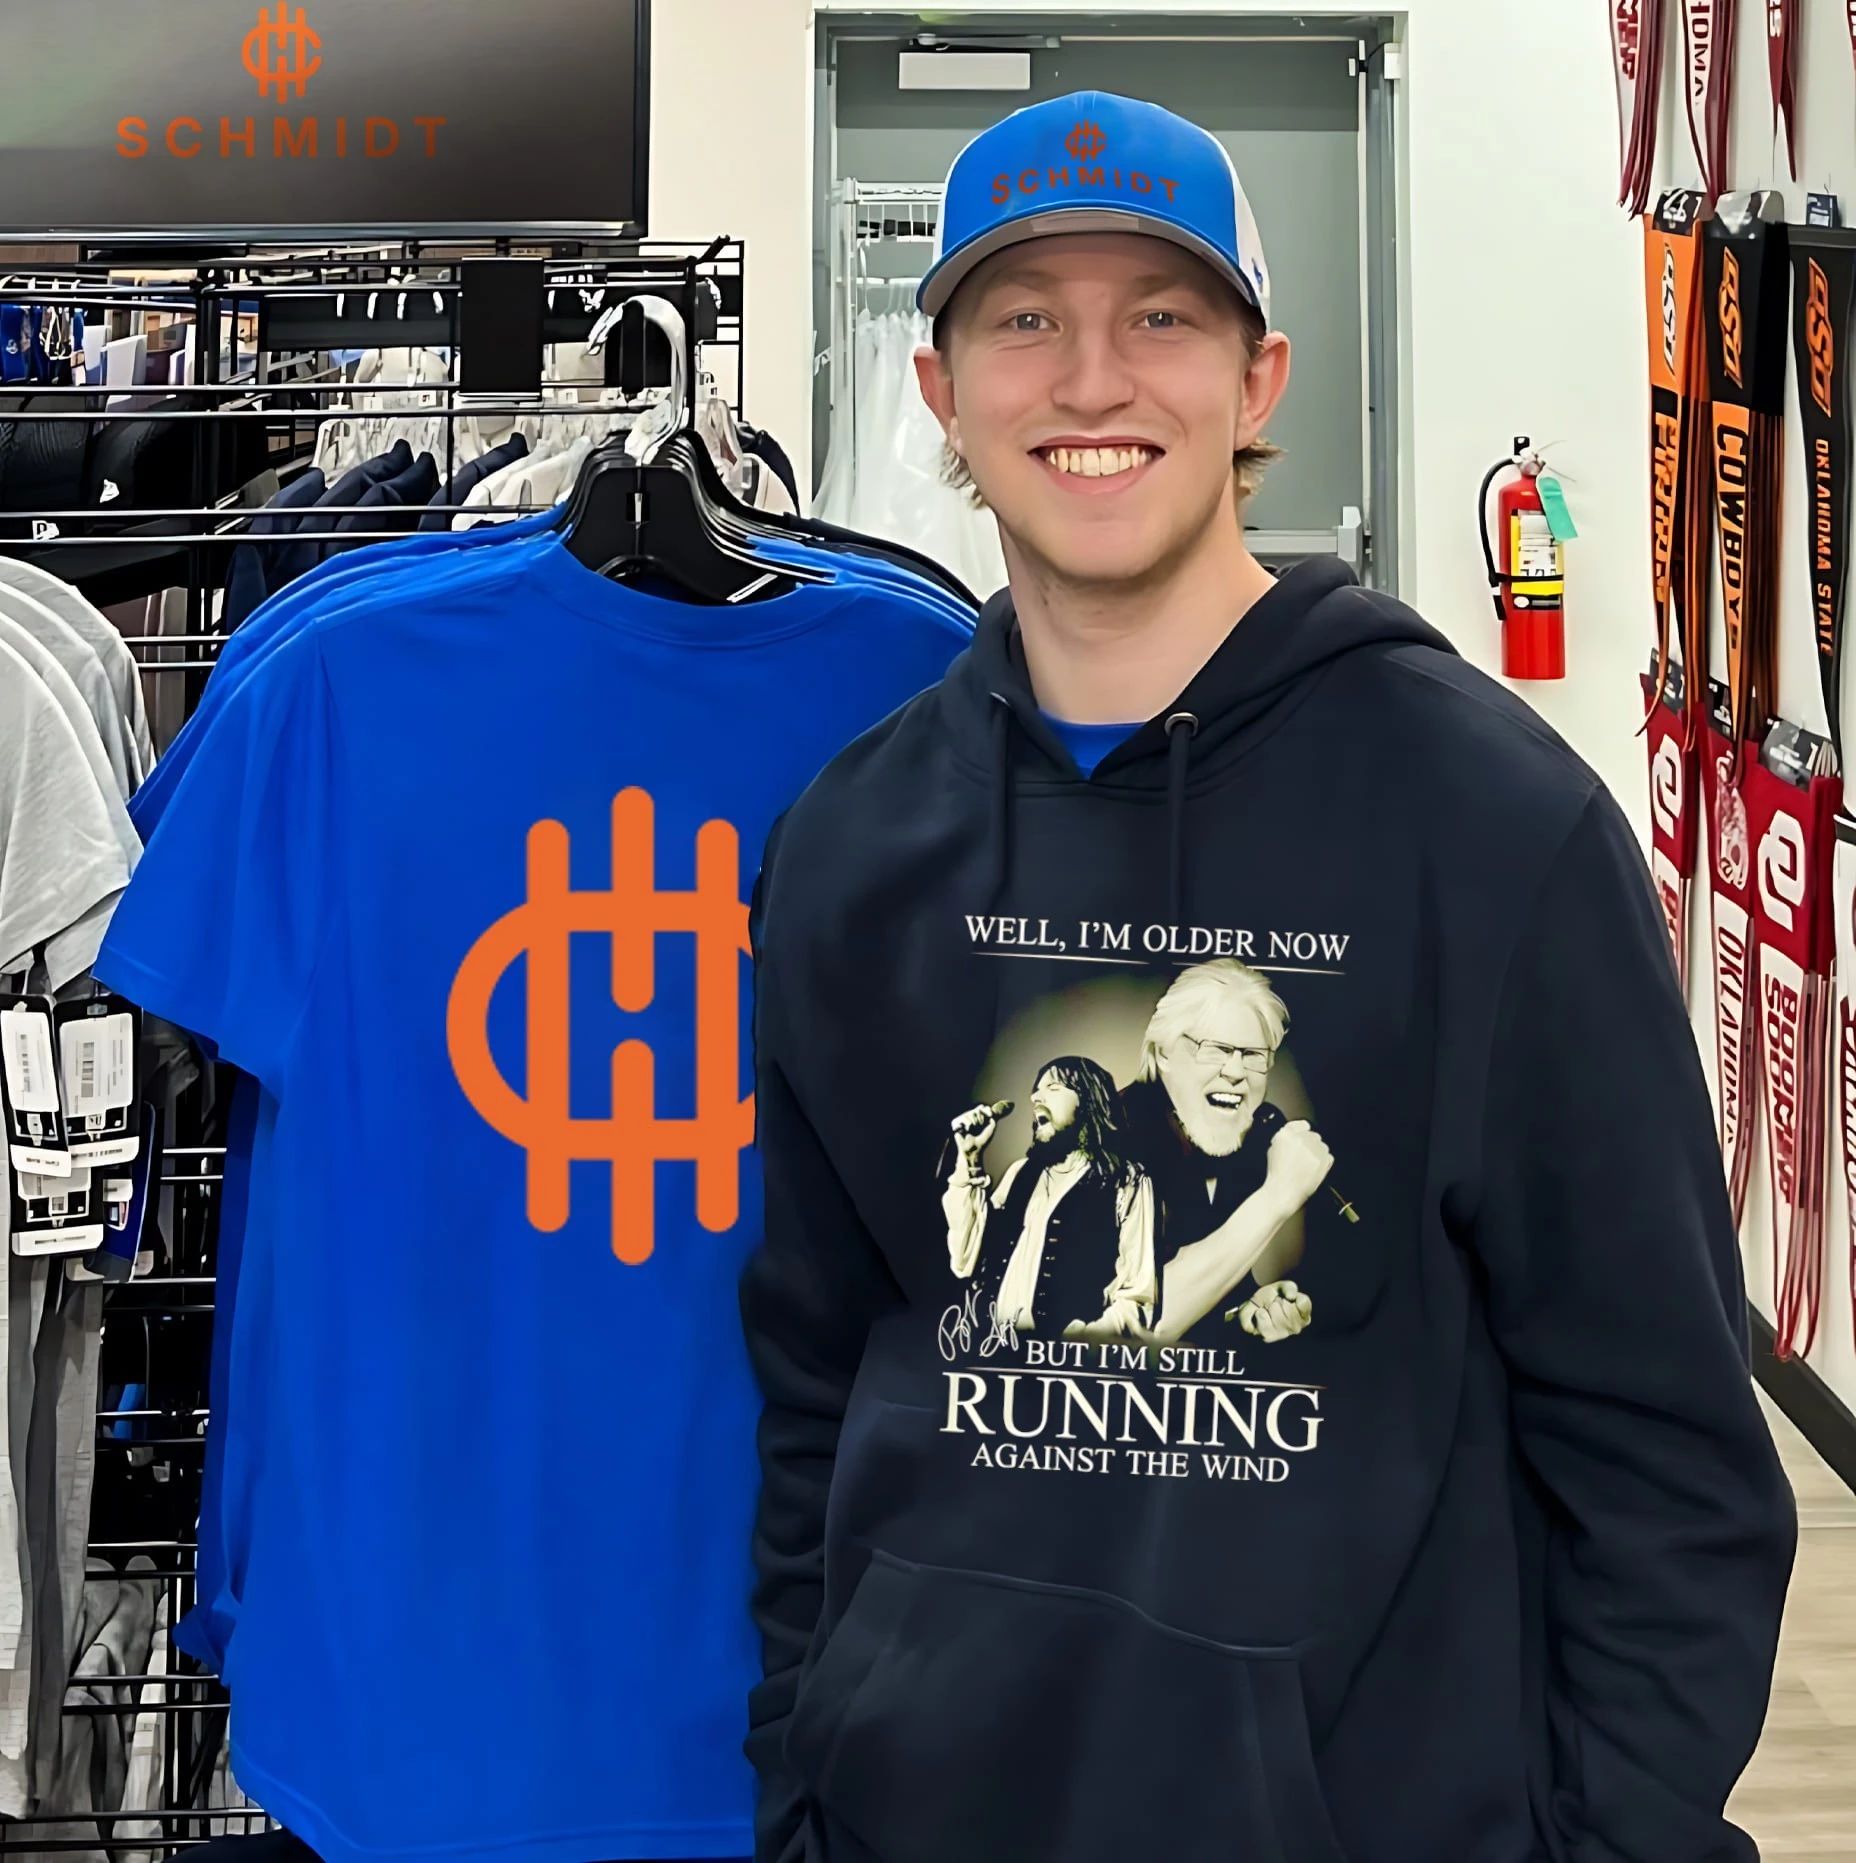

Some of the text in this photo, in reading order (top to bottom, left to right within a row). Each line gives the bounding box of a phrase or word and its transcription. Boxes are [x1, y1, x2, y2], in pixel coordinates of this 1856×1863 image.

[116, 116, 449, 159] SCHMIDT
[990, 167, 1181, 205] SCHMIDT
[965, 915, 1350, 962] WELL, I'M OLDER NOW
[1026, 1341, 1246, 1376] BUT I'M STILL
[939, 1372, 1324, 1453] RUNNING
[970, 1442, 1291, 1483] AGAINST THE WIND
